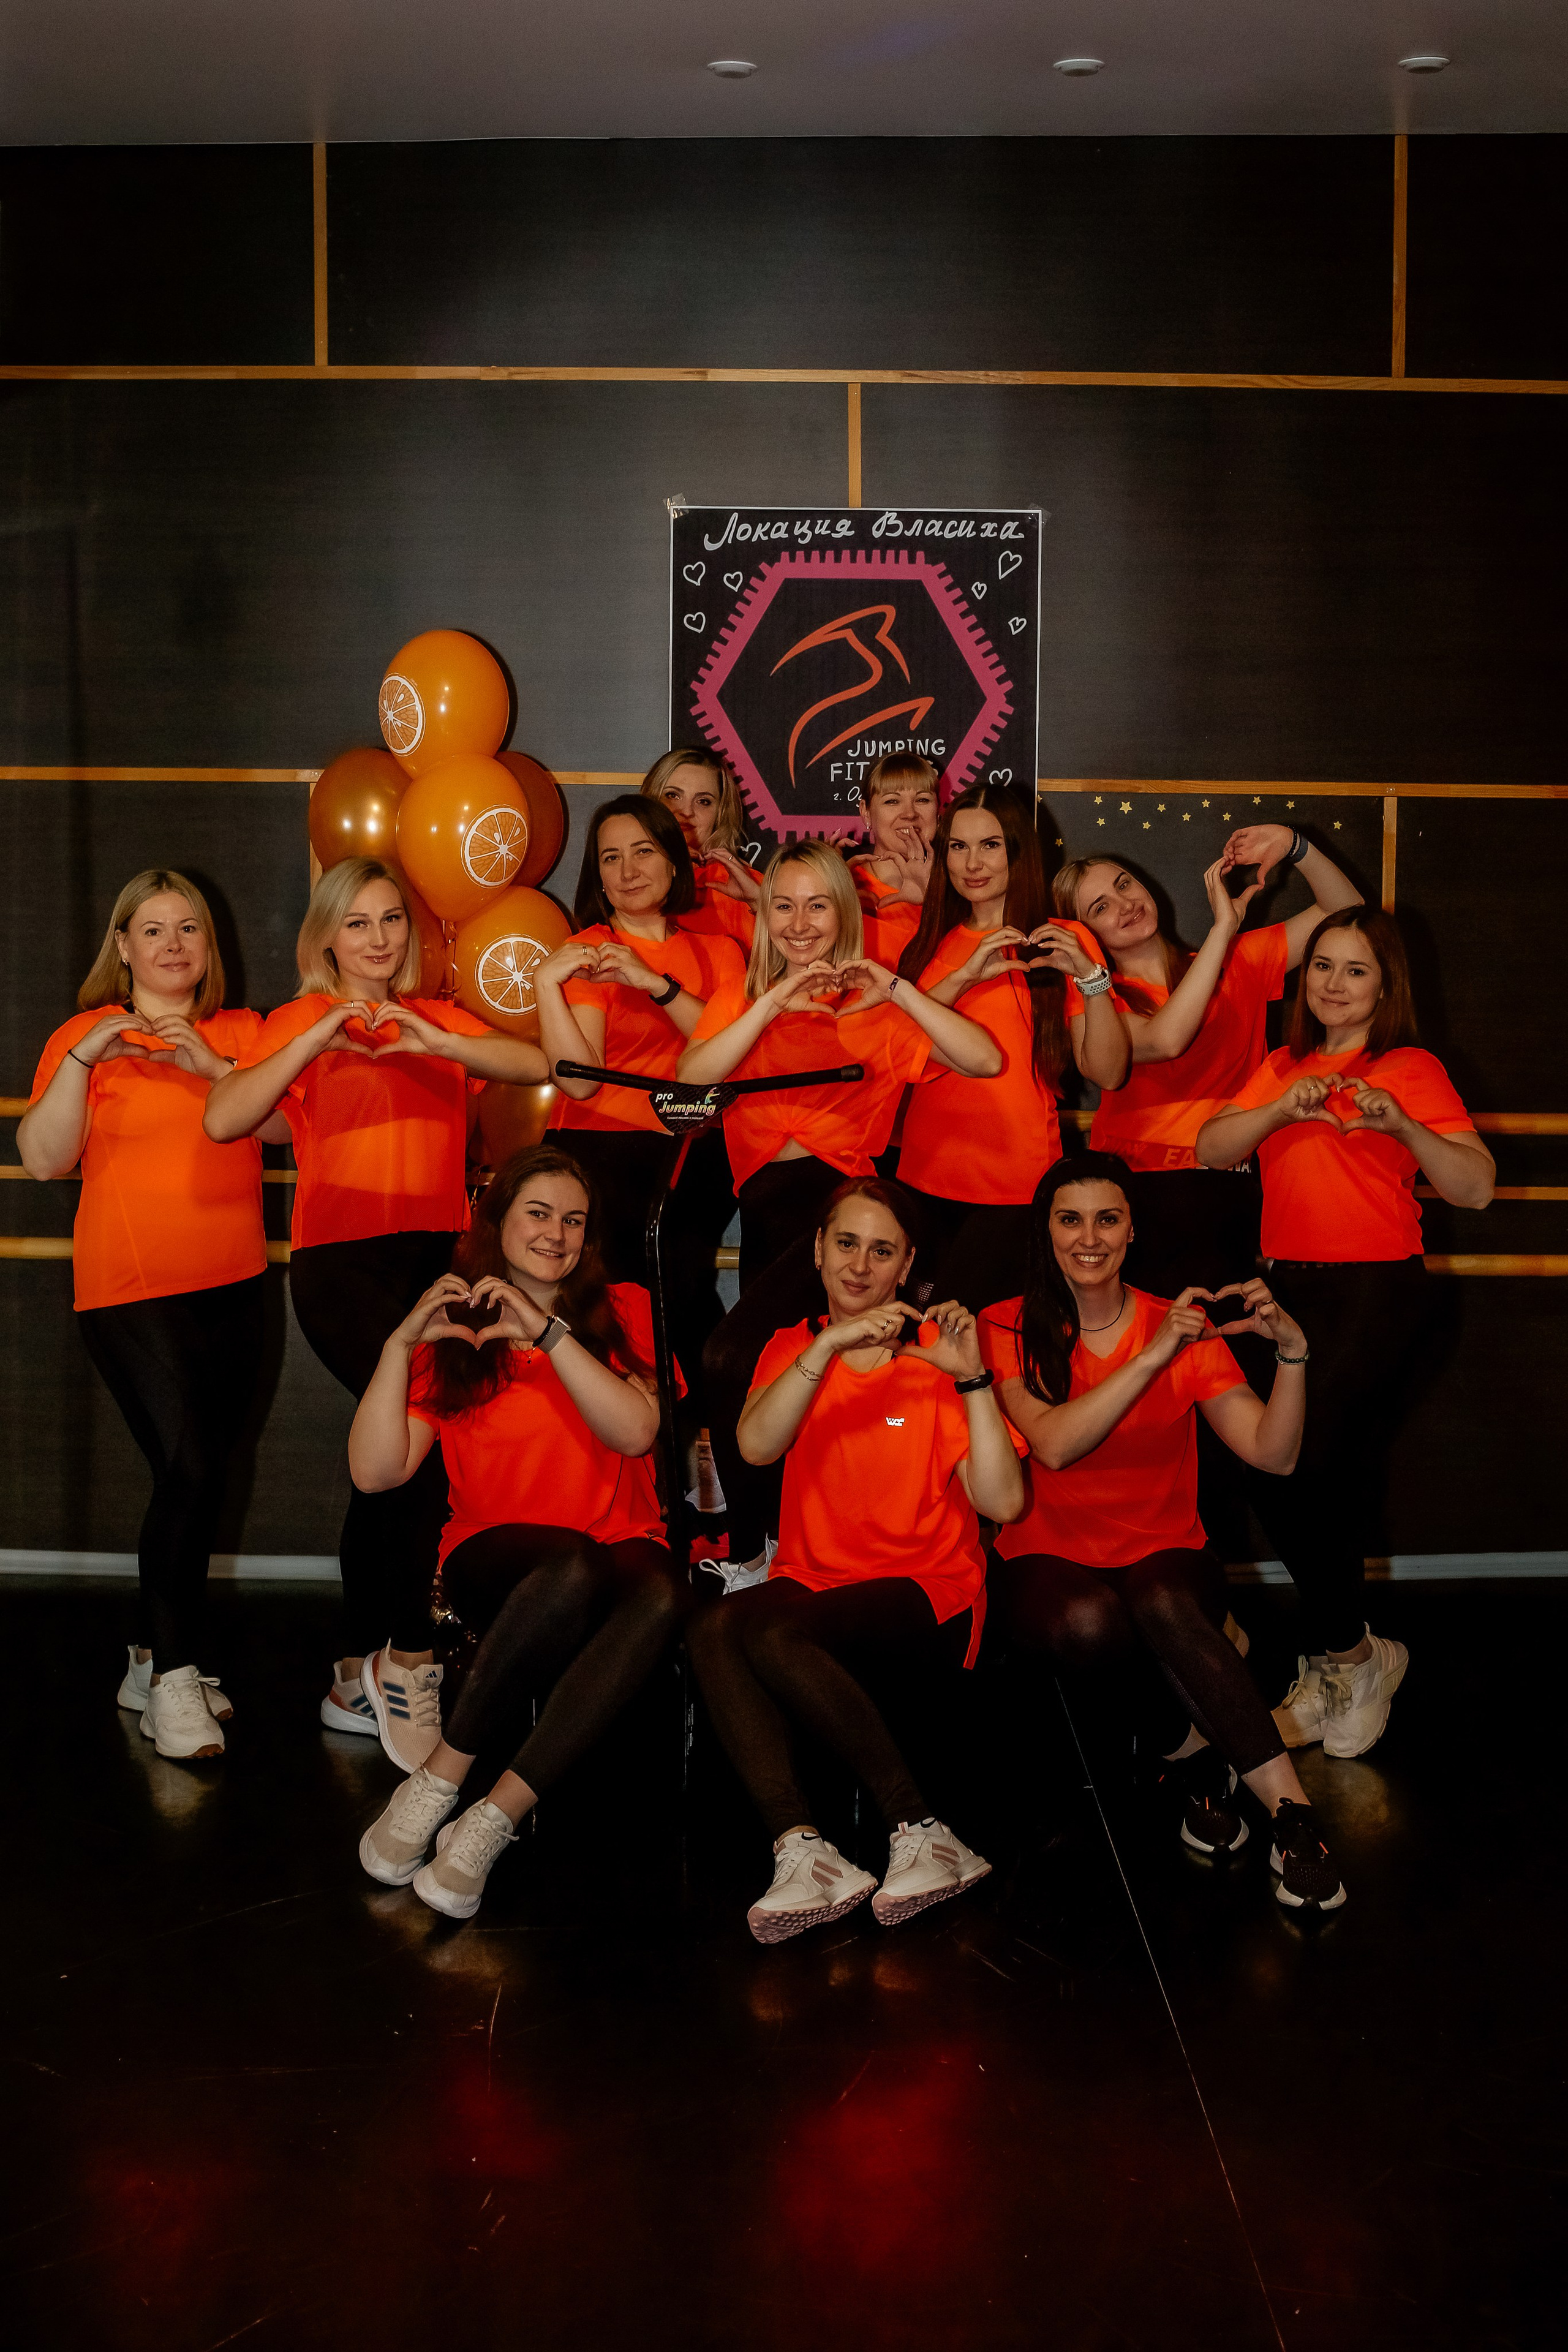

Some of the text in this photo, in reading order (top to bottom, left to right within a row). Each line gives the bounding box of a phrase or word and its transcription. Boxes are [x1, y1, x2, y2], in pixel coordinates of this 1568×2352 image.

[704, 511, 1025, 551] Локация Власиха
[847, 738, 946, 757] JUMPING
[655, 1093, 673, 1102] pro
[658, 1101, 716, 1116] Jumping
